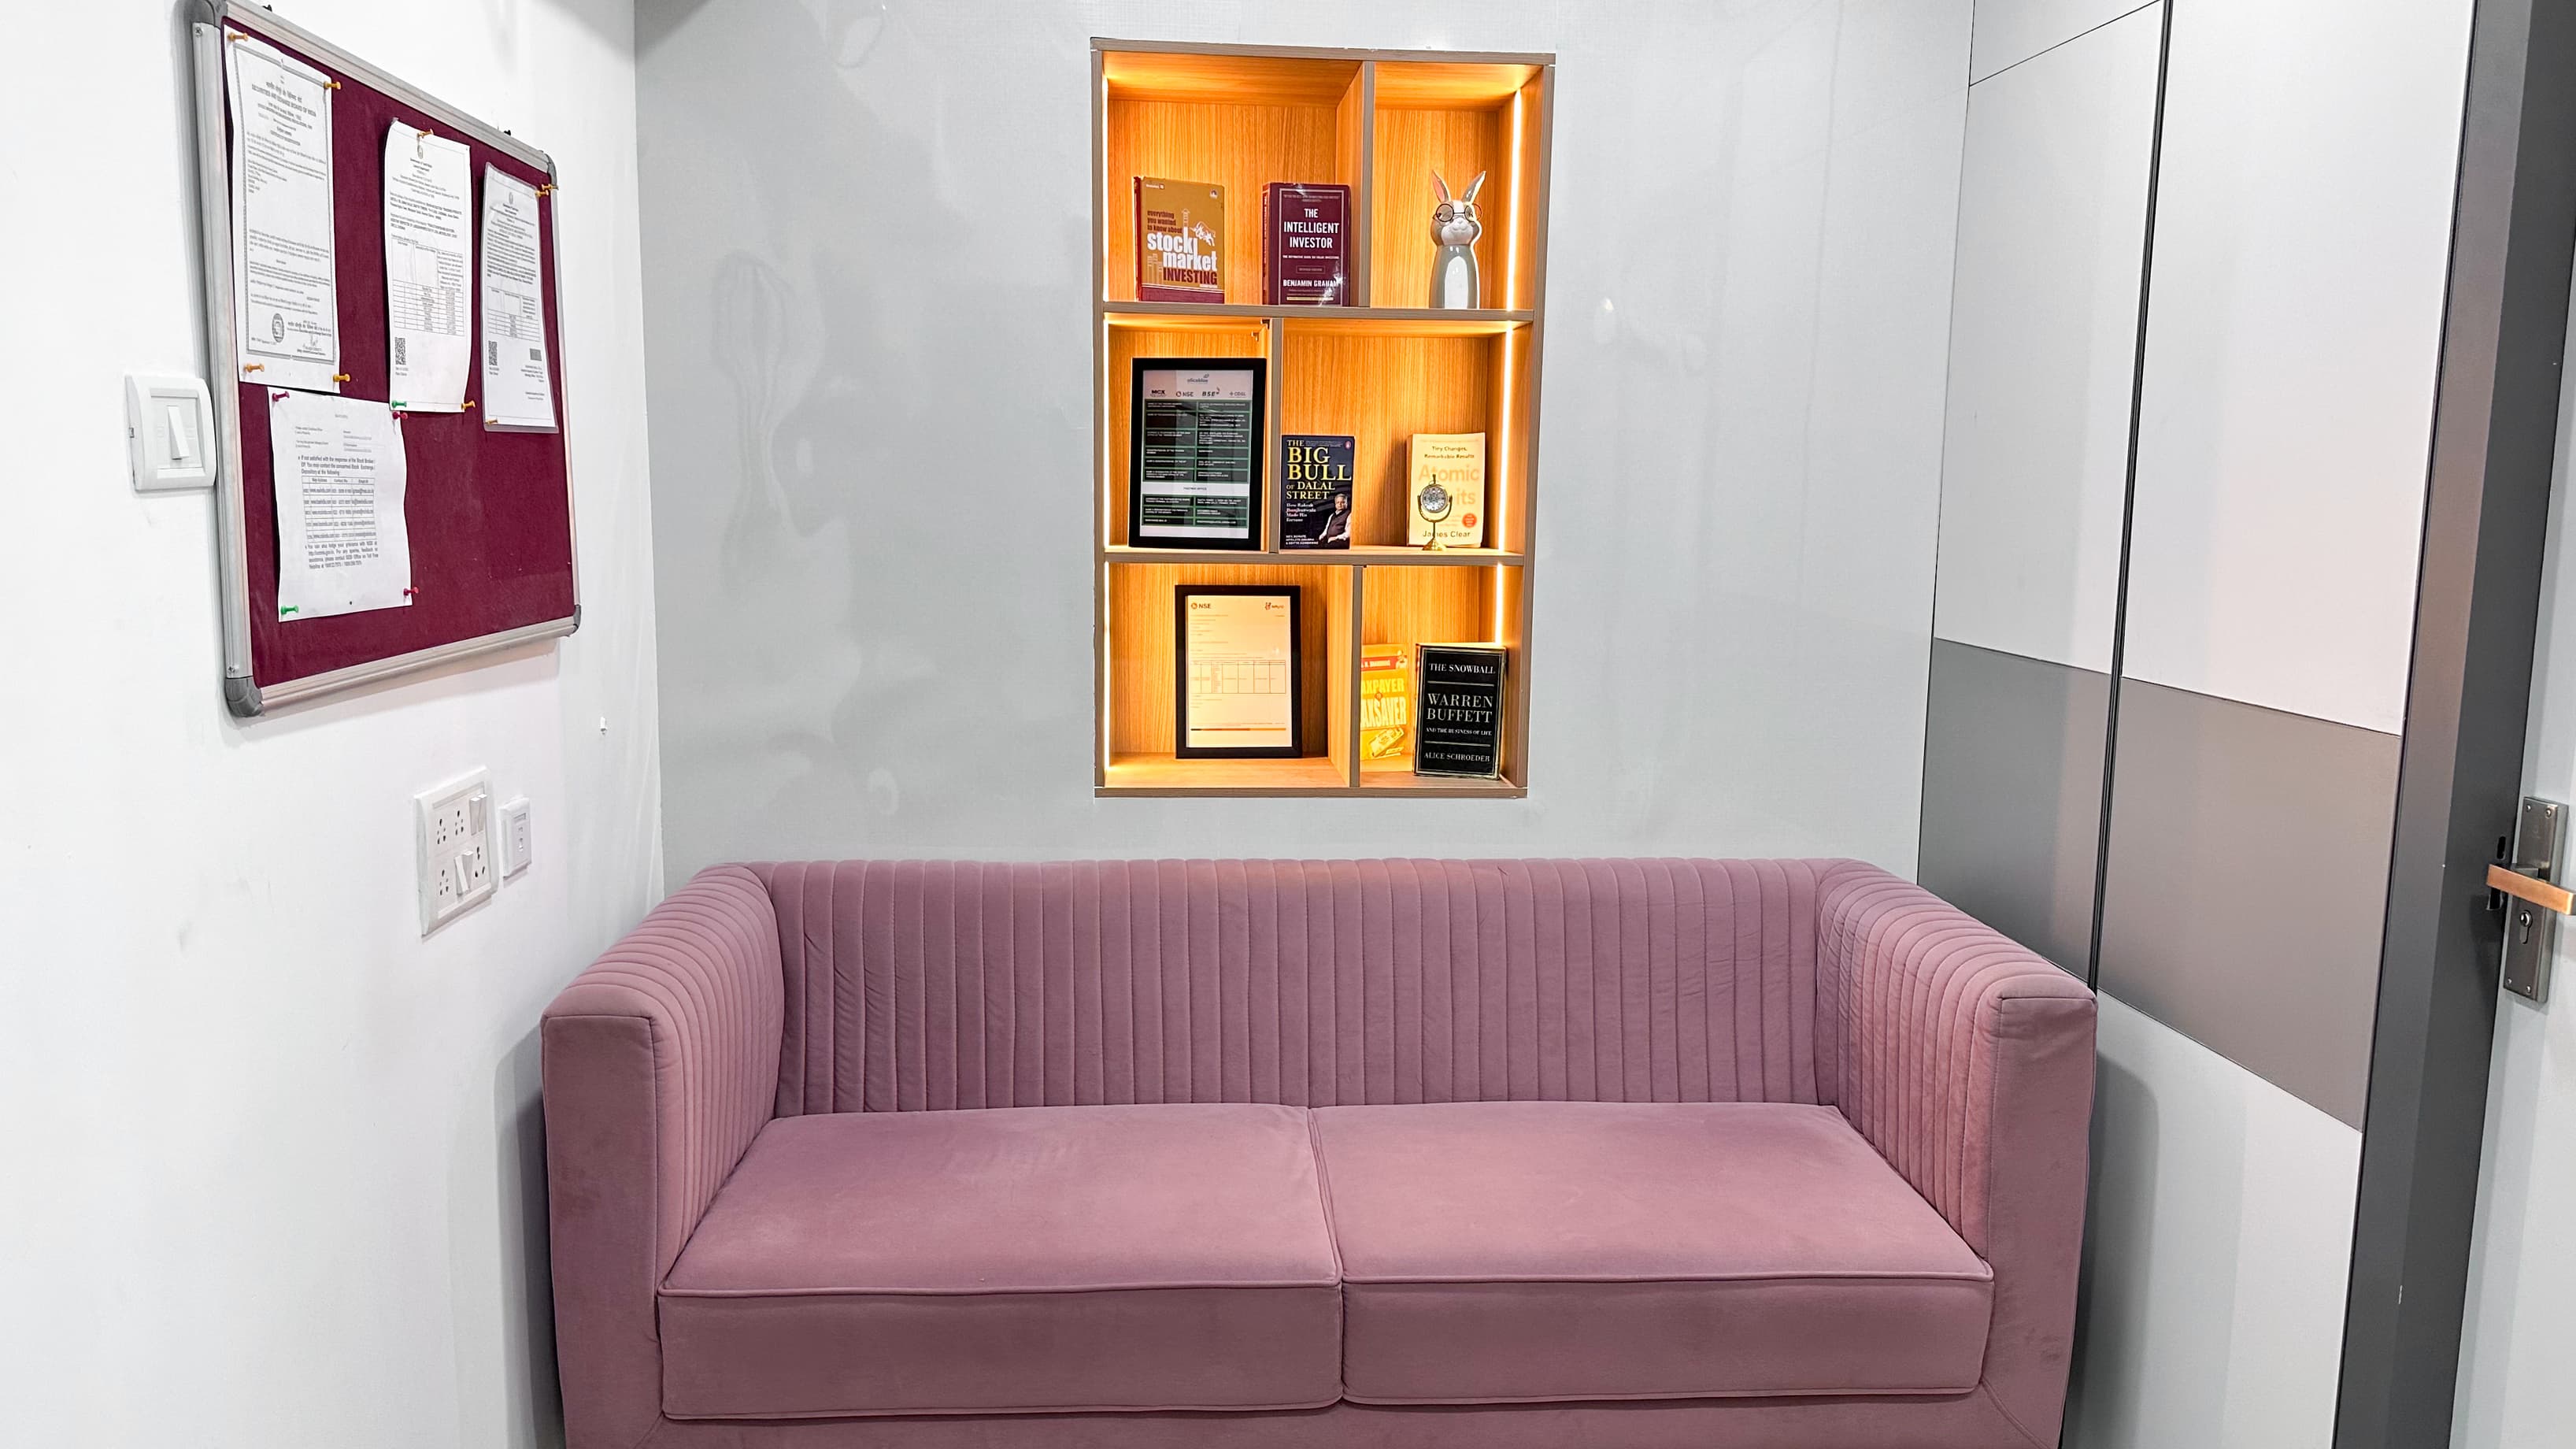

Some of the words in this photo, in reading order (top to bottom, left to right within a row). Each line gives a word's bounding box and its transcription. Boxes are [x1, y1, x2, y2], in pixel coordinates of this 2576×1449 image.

[1147, 210, 1175, 219] everything
[1305, 209, 1318, 217] THE
[1284, 222, 1339, 233] INTELLIGENT
[1147, 227, 1194, 254] stock
[1290, 237, 1332, 249] INVESTOR
[1163, 238, 1217, 272] market
[1164, 268, 1217, 285] INVESTING
[1288, 447, 1331, 463] BIG
[1287, 464, 1351, 480] BULL
[1428, 663, 1447, 672] THE
[1449, 664, 1496, 674] SNOWBALL
[1361, 678, 1405, 693] AXPAYER
[1427, 693, 1493, 708] WARREN
[1361, 696, 1407, 728] AXSAVER
[1427, 709, 1492, 723] BUFFETT
